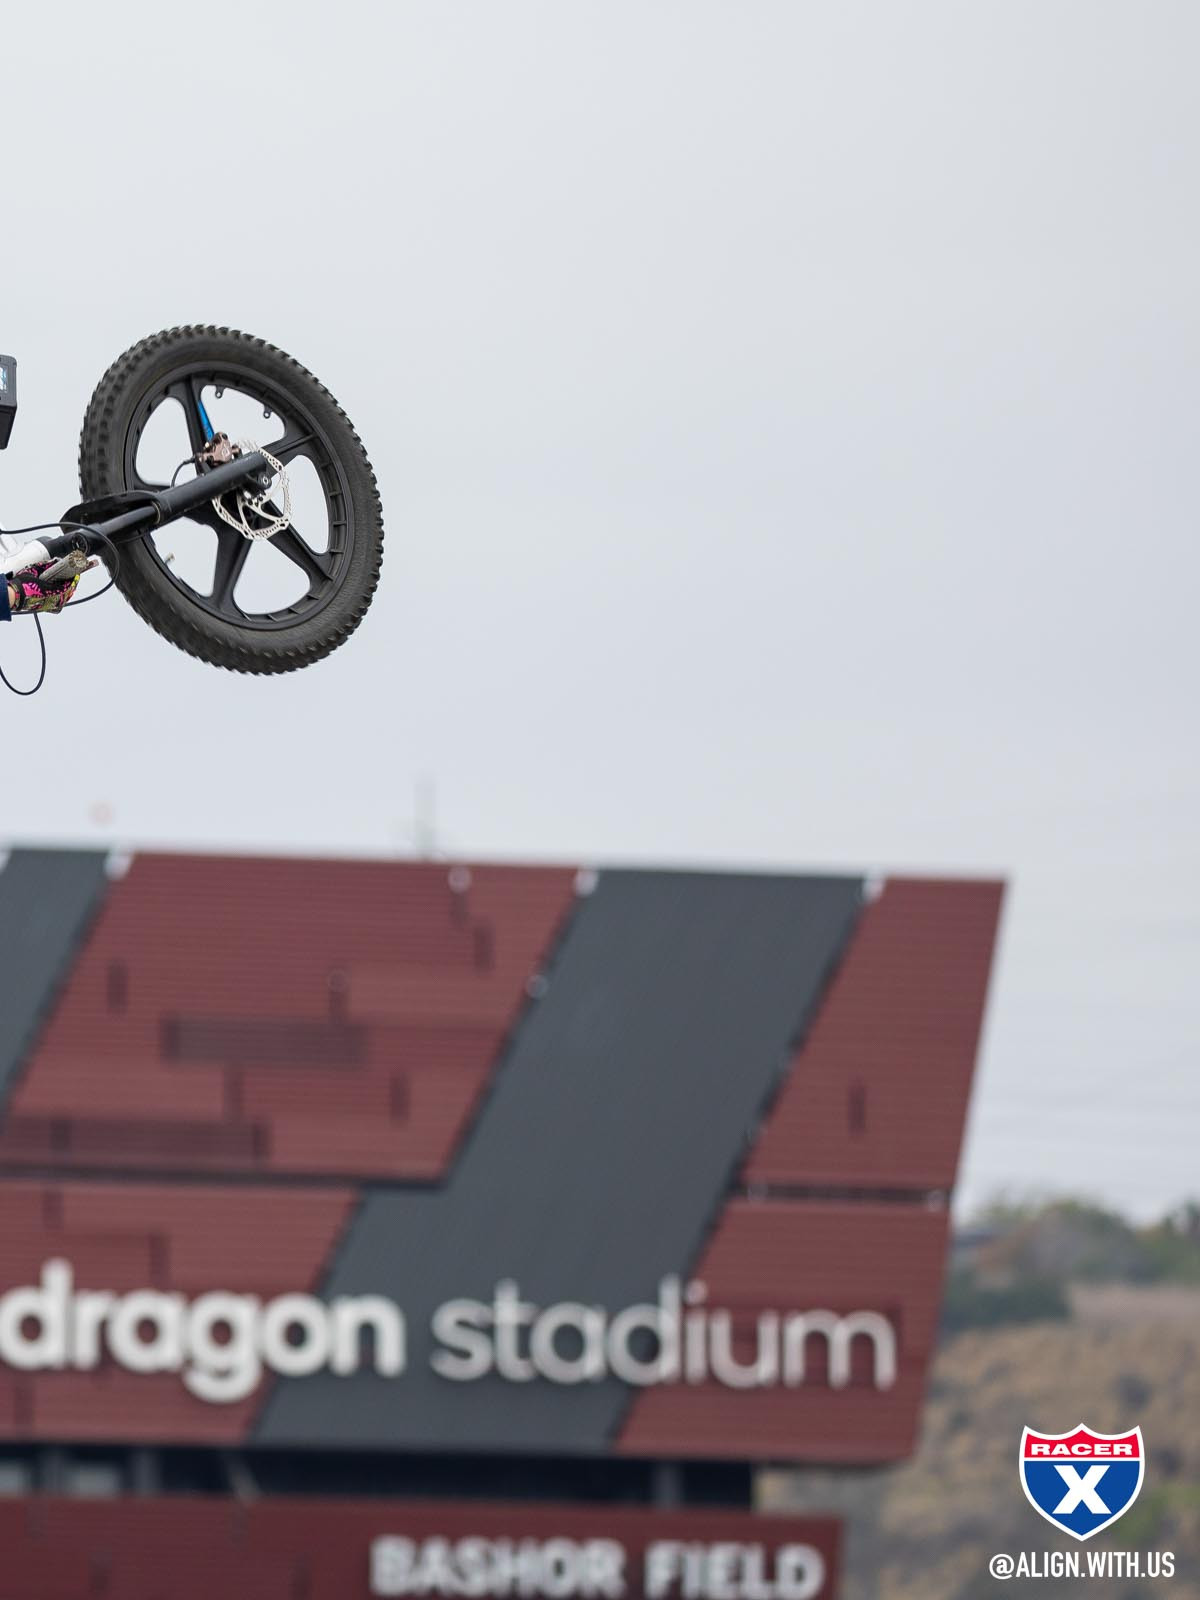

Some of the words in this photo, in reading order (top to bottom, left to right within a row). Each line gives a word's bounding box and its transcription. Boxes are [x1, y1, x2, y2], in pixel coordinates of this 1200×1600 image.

[430, 1276, 895, 1390] stadium
[369, 1536, 625, 1599] BASHOR
[644, 1541, 826, 1600] FIELD
